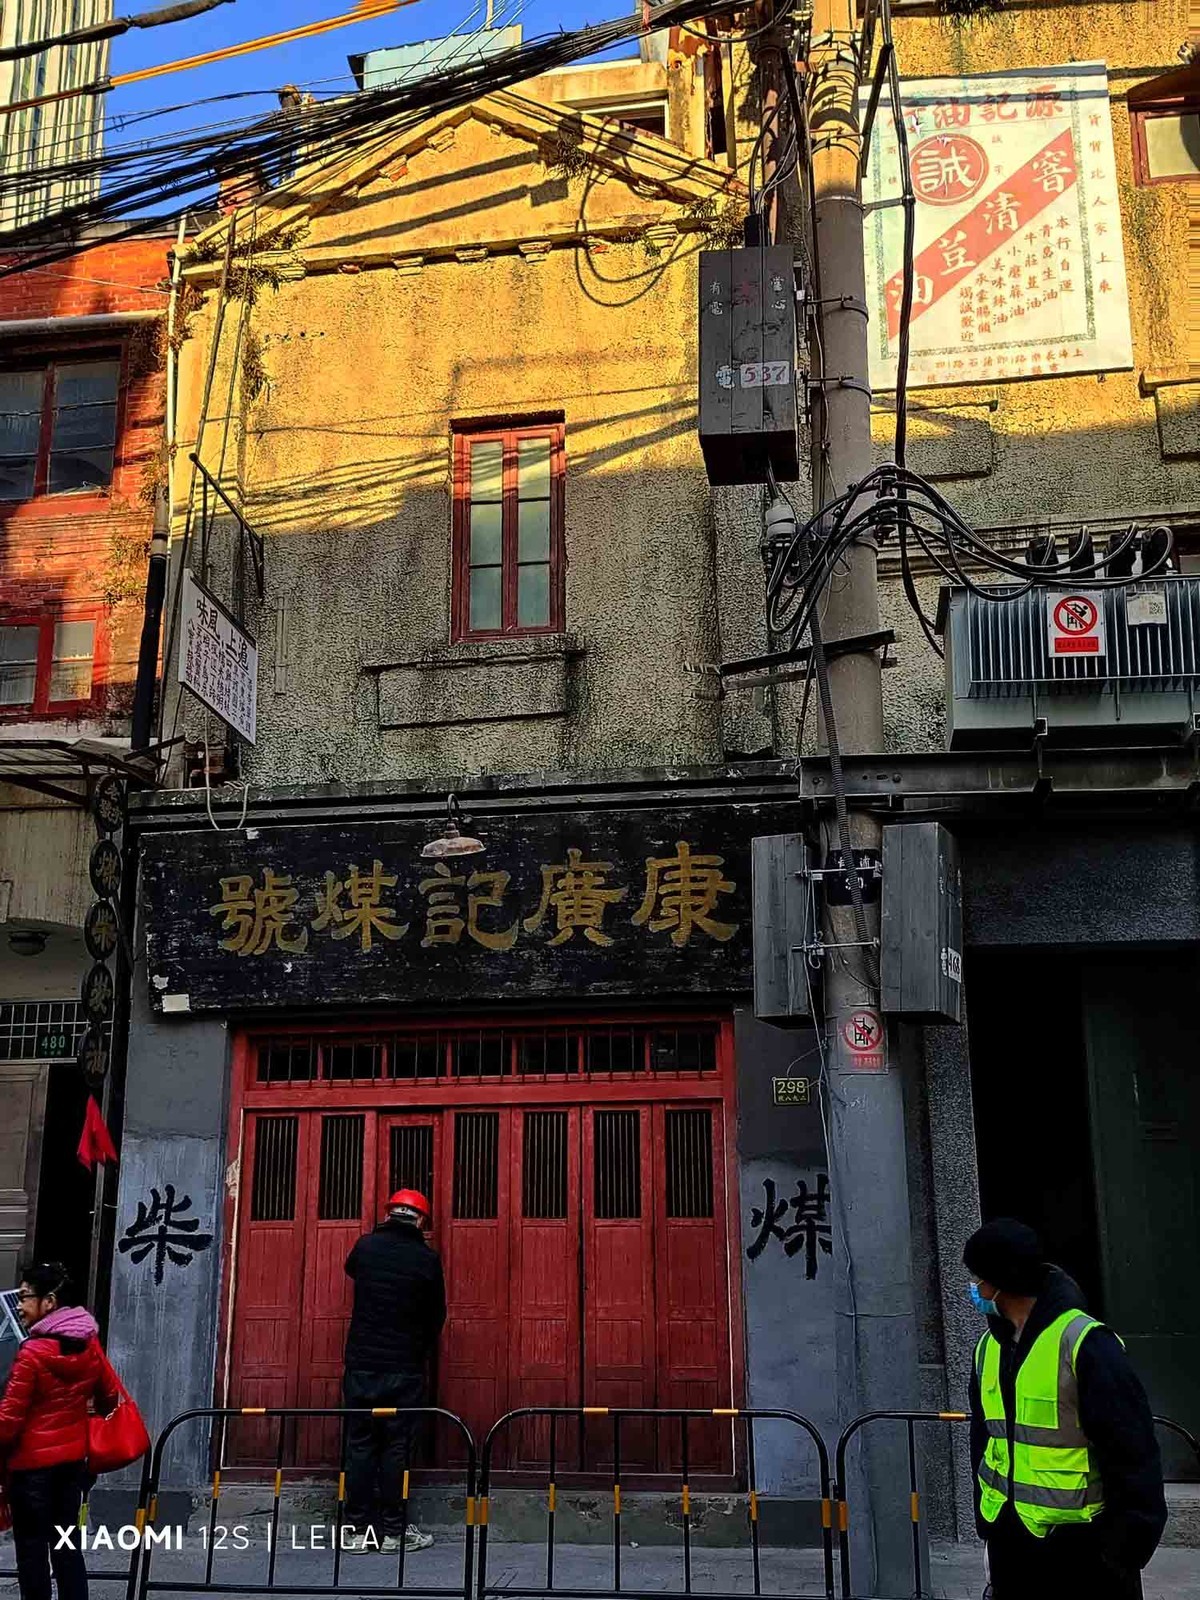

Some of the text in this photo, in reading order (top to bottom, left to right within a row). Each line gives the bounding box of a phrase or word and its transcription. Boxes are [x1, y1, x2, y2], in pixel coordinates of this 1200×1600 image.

[915, 147, 977, 195] 誠
[744, 366, 787, 383] 537
[209, 840, 740, 958] 康廣記煤號
[41, 1034, 66, 1050] 480
[777, 1081, 806, 1094] 298
[118, 1184, 214, 1287] 柴
[746, 1173, 832, 1281] 煤
